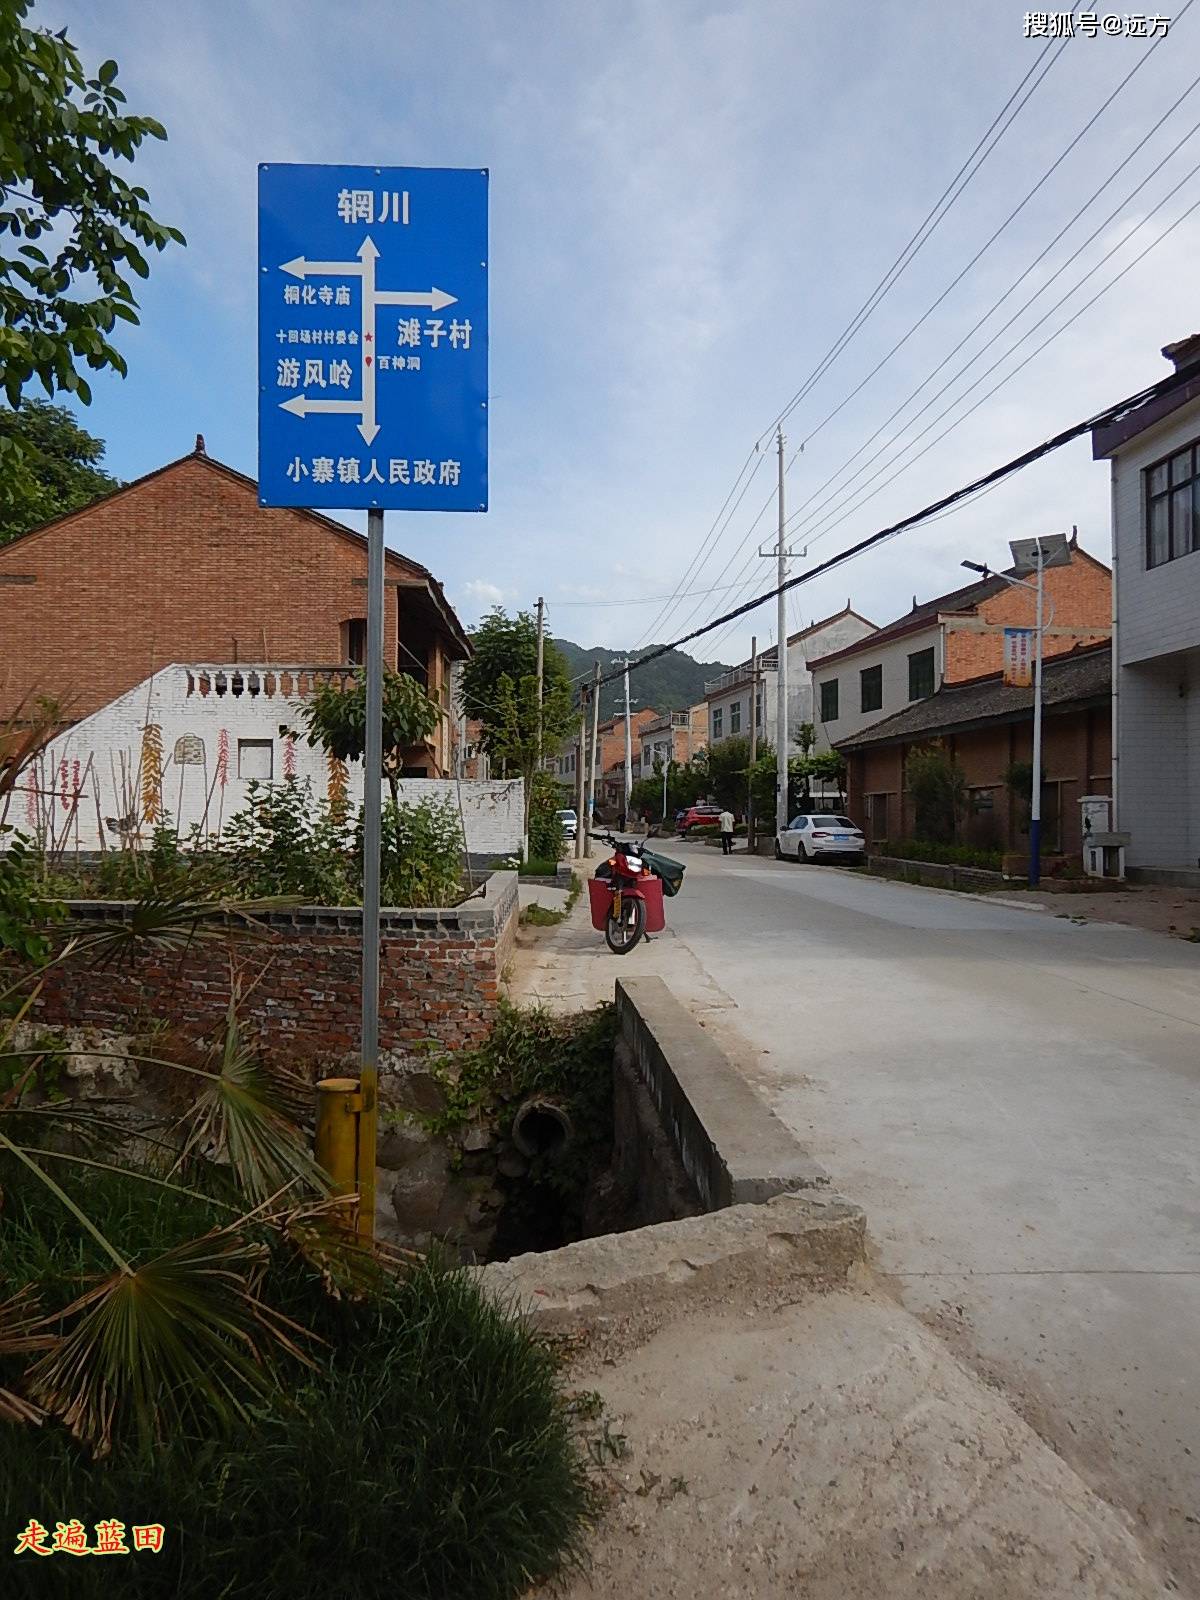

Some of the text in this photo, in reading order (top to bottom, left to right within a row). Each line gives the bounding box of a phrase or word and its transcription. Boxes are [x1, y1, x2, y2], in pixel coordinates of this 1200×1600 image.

[338, 188, 409, 225] 辋川
[397, 318, 473, 349] 滩子村
[276, 358, 353, 389] 游风岭
[286, 456, 461, 486] 小寨镇人民政府
